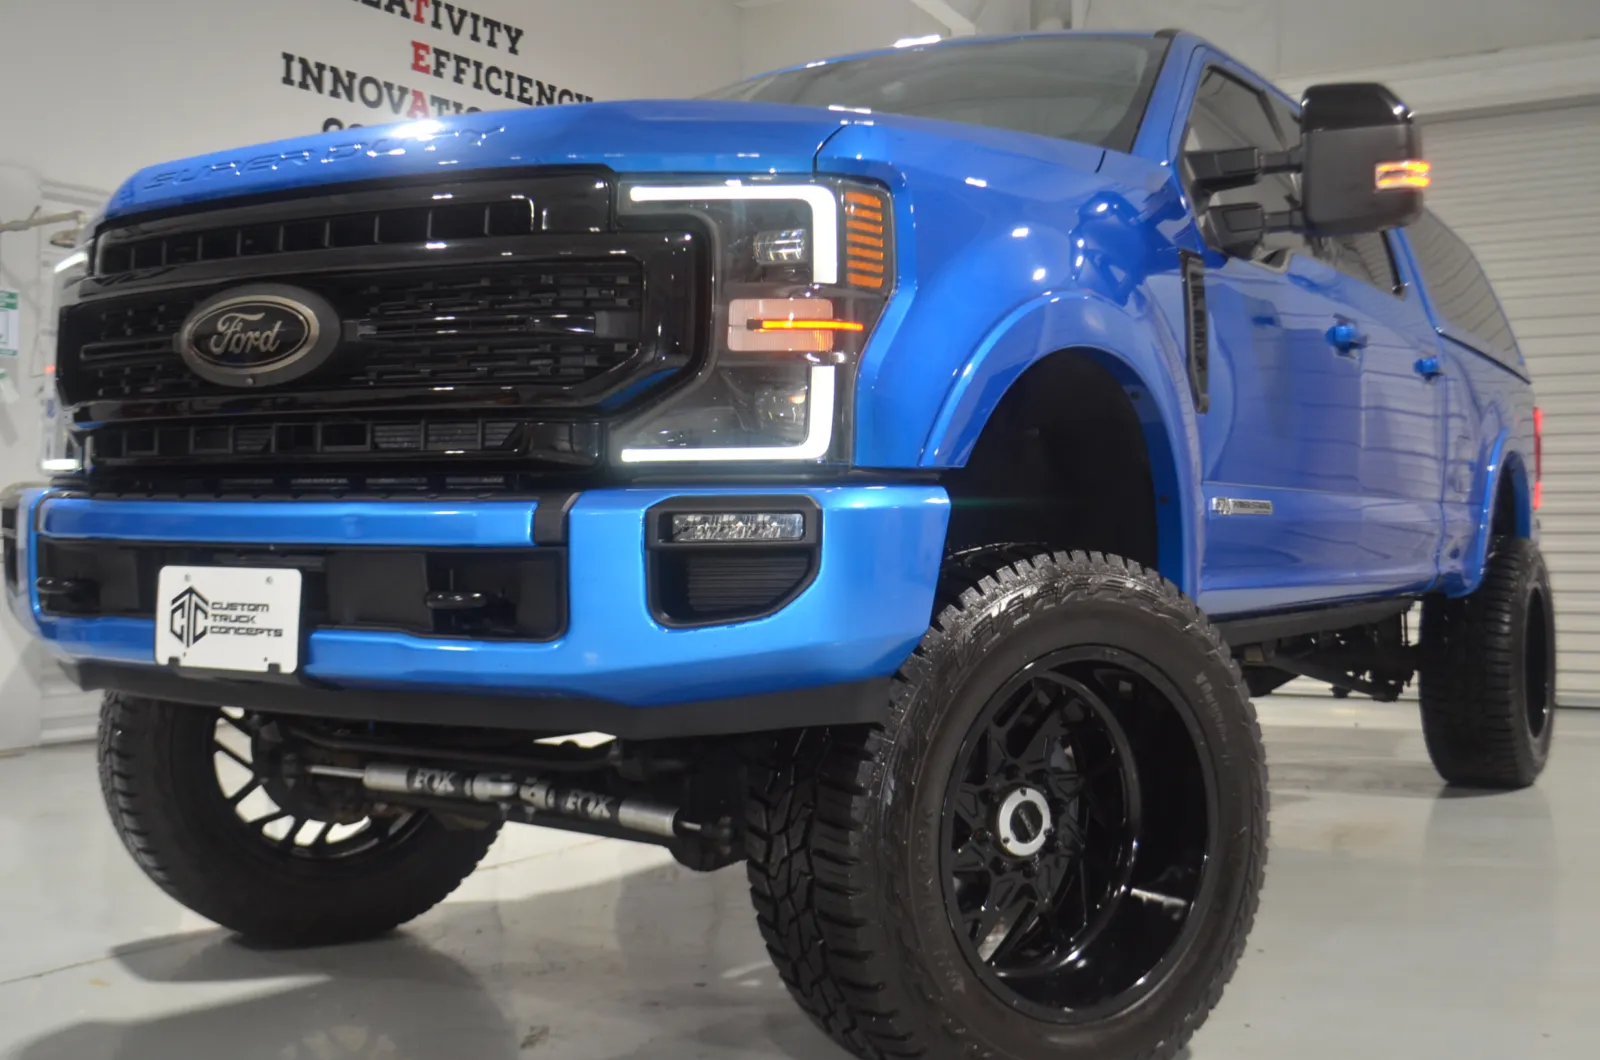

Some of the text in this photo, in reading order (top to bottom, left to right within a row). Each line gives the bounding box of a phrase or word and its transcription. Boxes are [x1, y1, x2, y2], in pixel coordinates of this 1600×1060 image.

[353, 0, 524, 55] ATIVITY
[281, 52, 482, 118] INNOVAT
[210, 312, 284, 354] Ford
[211, 601, 269, 612] CUSTOM
[211, 613, 257, 624] TRUCK
[209, 625, 283, 637] CONCEPTS
[413, 768, 456, 793] FOX
[565, 789, 612, 818] FOX
